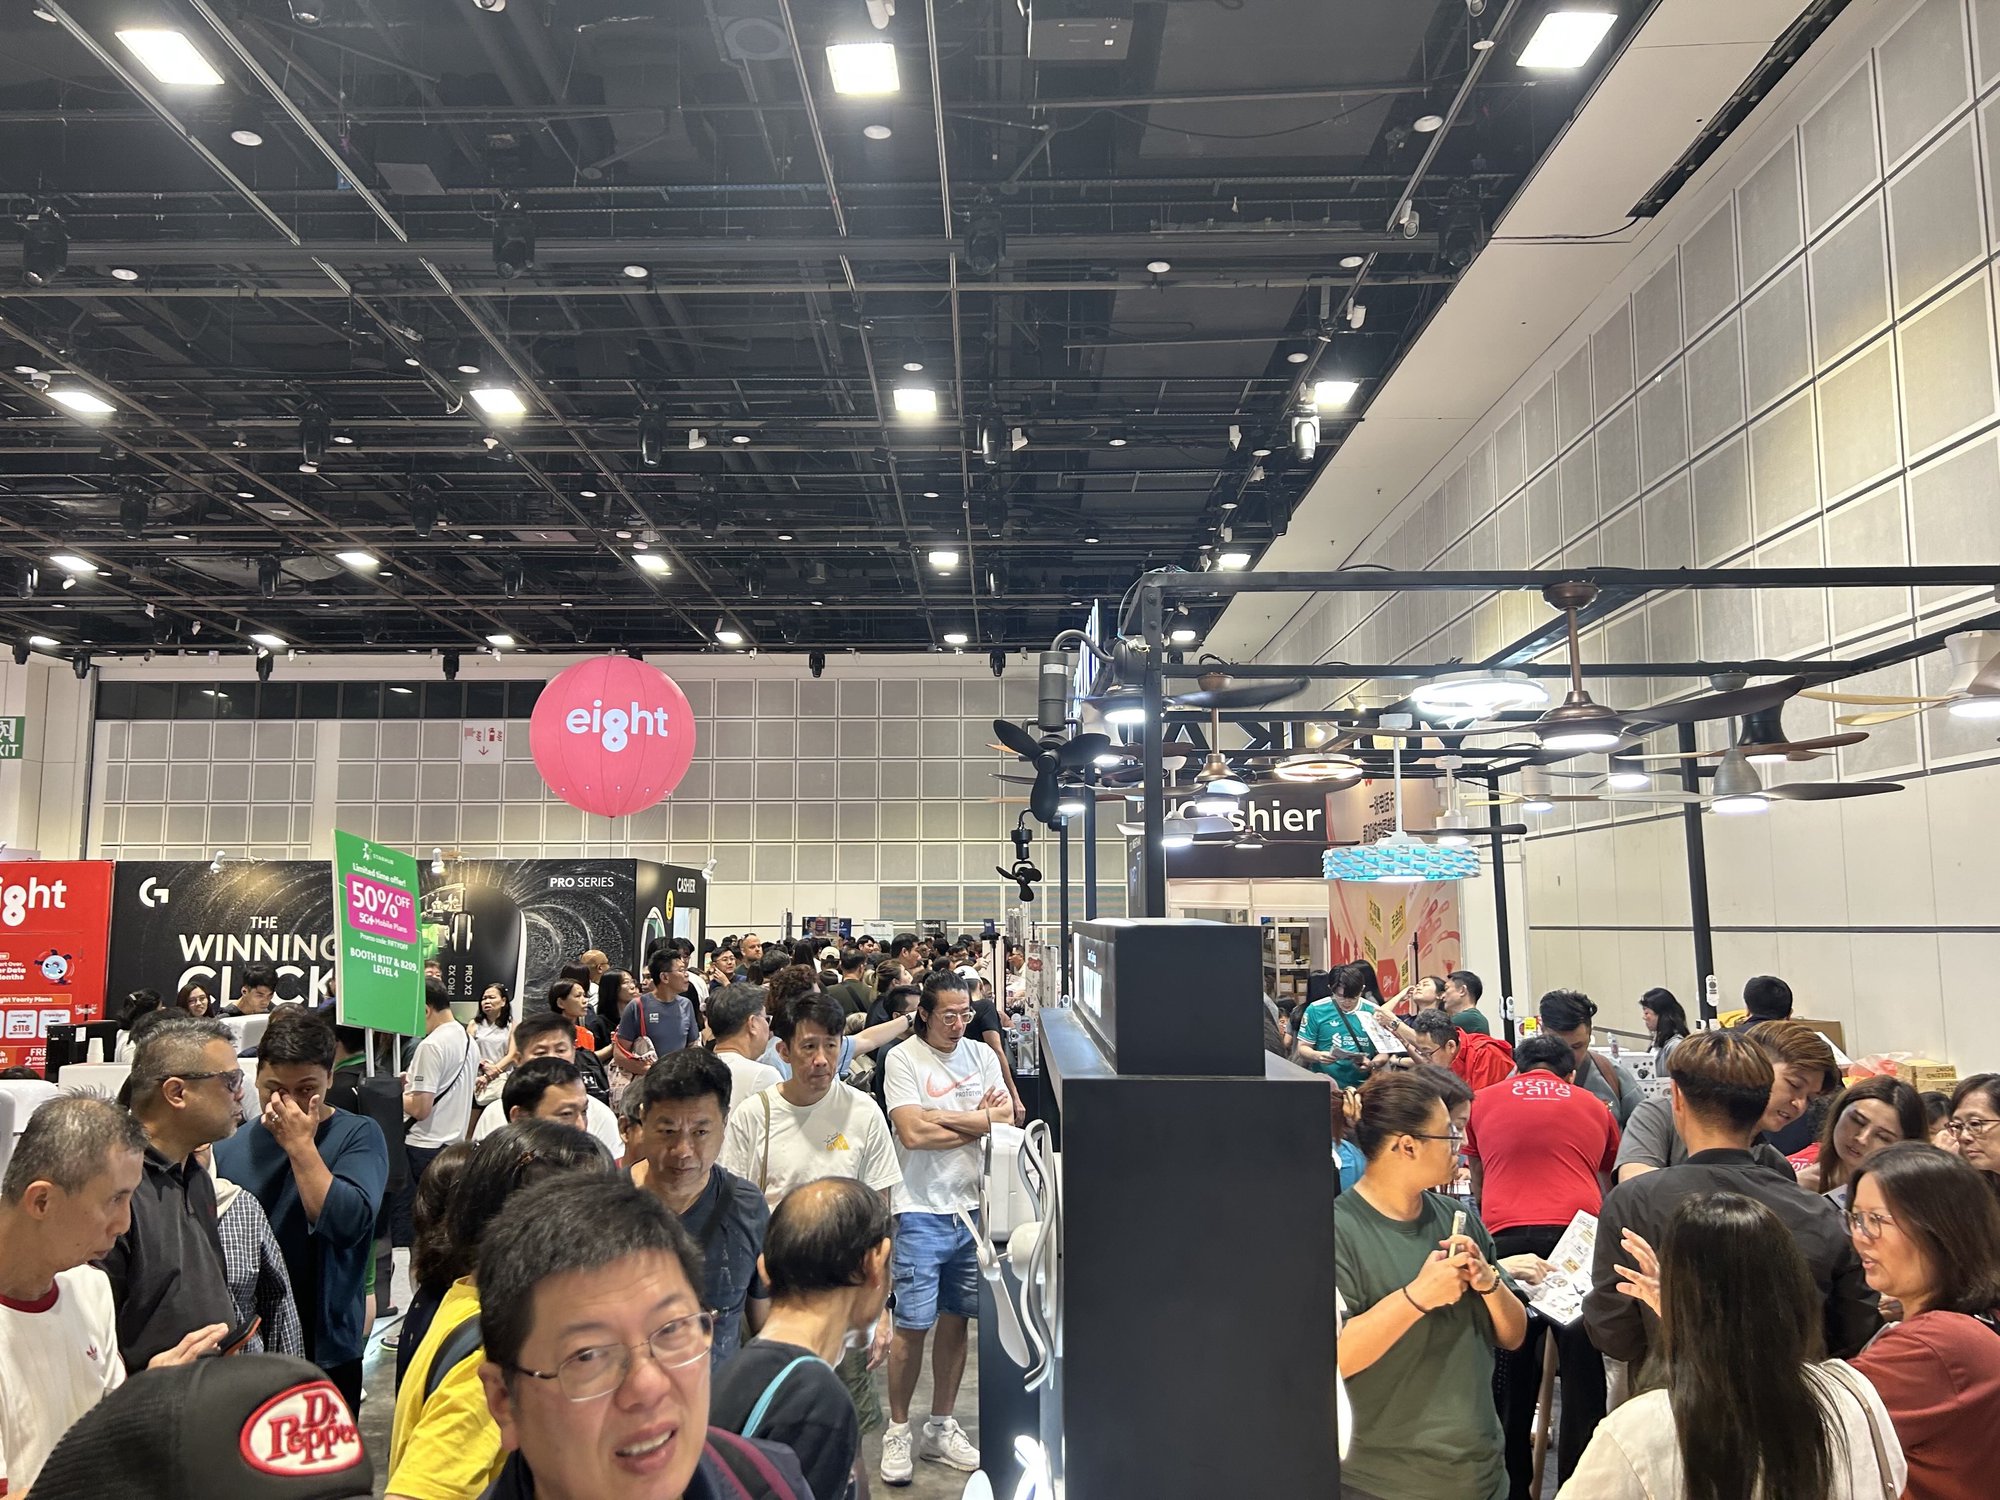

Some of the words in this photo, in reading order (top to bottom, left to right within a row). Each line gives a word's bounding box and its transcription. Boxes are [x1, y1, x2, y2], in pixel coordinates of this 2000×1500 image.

[566, 699, 668, 752] eight
[352, 862, 376, 877] Limited
[376, 871, 390, 882] time
[550, 878, 575, 888] PRO
[576, 876, 614, 888] SERIES
[676, 878, 696, 893] CASHIER
[352, 880, 398, 918] 50%
[394, 894, 410, 908] OFF
[250, 916, 278, 928] THE
[374, 918, 393, 930] Mobile
[393, 922, 408, 934] Plans
[350, 947, 376, 961] BOOTH
[378, 954, 392, 964] 8117
[394, 959, 400, 968] &
[373, 964, 393, 977] LEVEL
[394, 970, 399, 978] 4
[448, 965, 456, 976] X2
[178, 965, 334, 1008] CLCK
[448, 978, 456, 996] PRO
[464, 984, 472, 996] X2
[25, 1057, 32, 1066] 2
[1512, 1086, 1571, 1097] care
